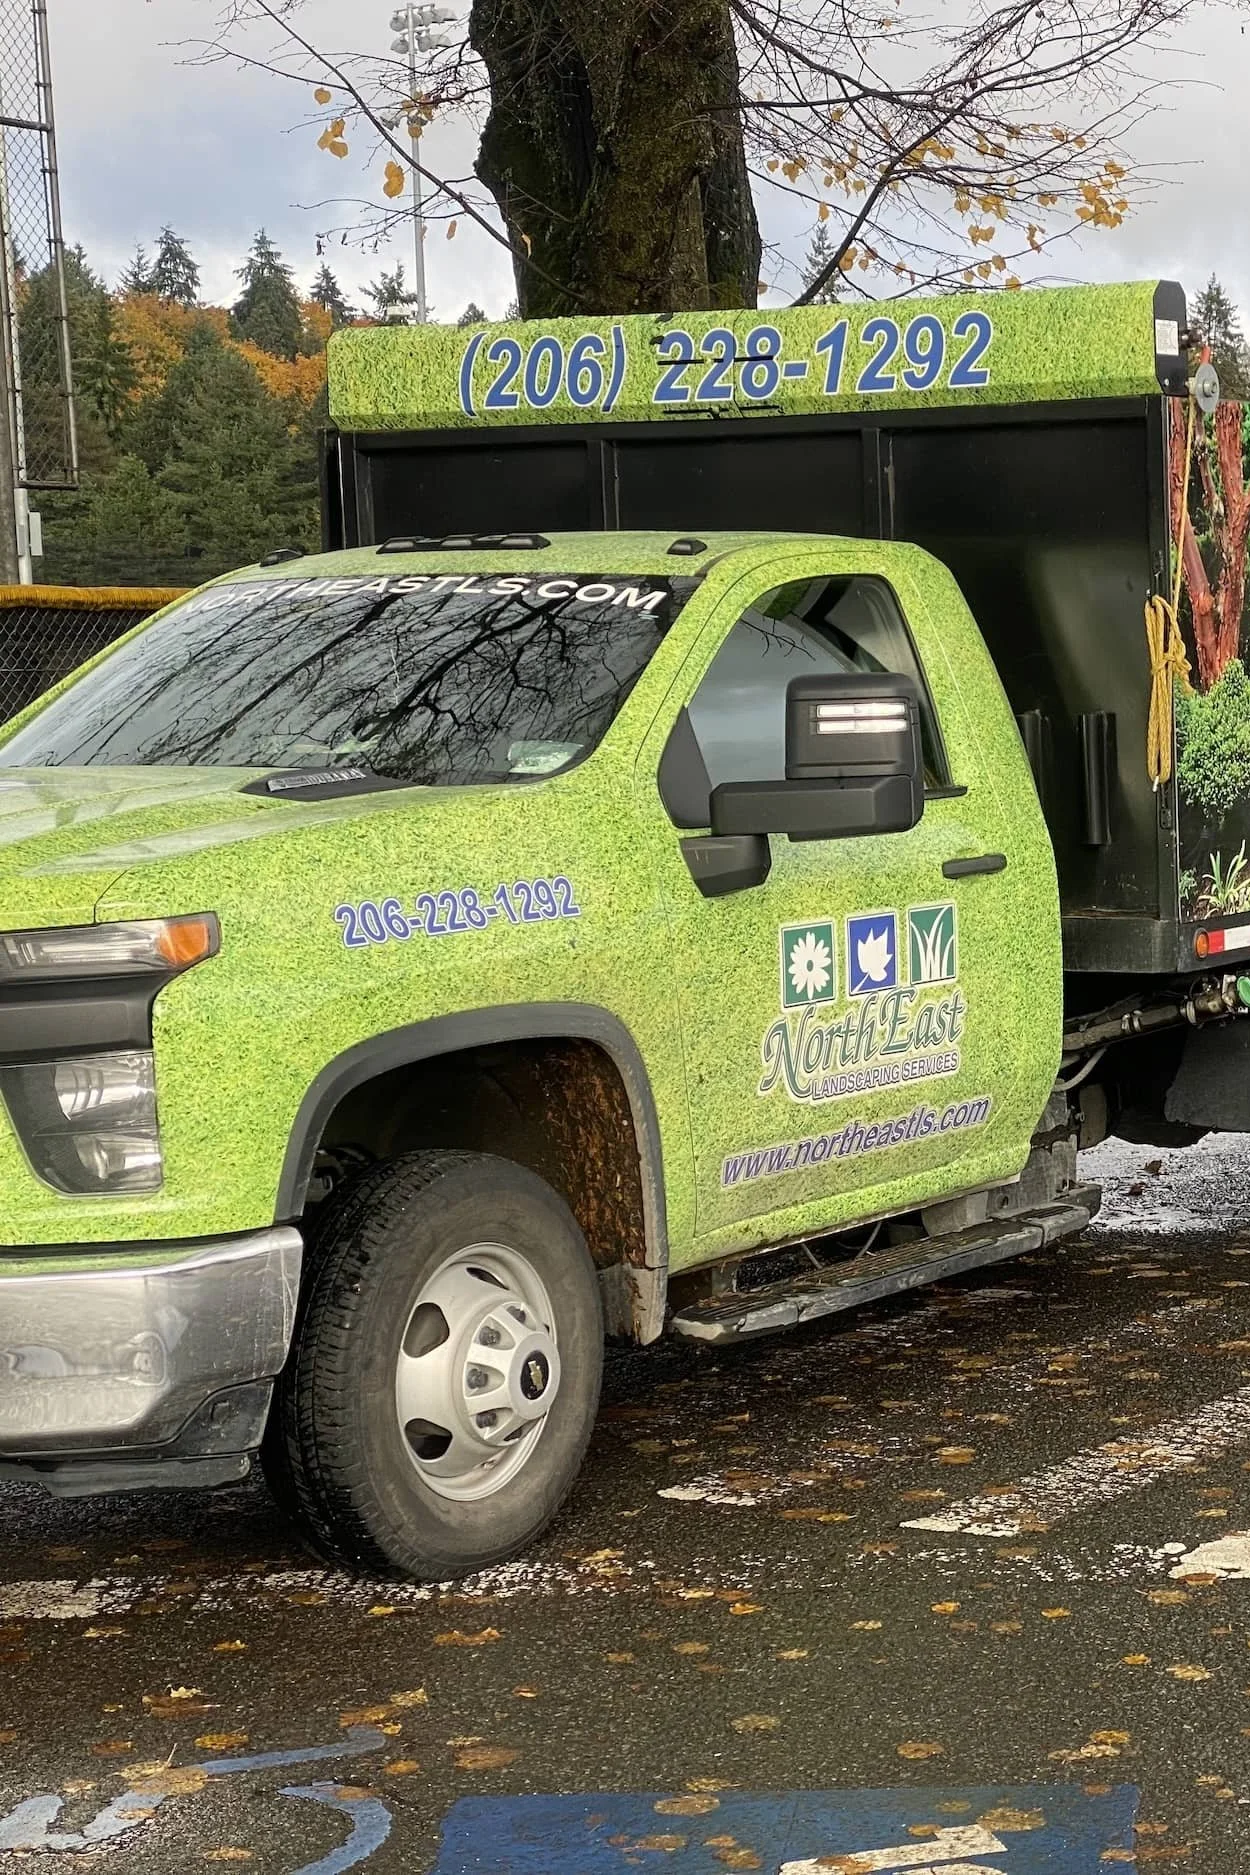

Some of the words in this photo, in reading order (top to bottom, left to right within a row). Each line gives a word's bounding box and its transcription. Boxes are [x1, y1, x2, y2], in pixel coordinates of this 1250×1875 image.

[461, 325, 625, 418] (206)
[652, 310, 993, 404] 228-1292
[334, 875, 580, 948] 206-228-1292
[811, 1065, 900, 1100] LANDSCAPING
[901, 1052, 958, 1081] SERVICES
[722, 1096, 991, 1186] www.northeastls.com
